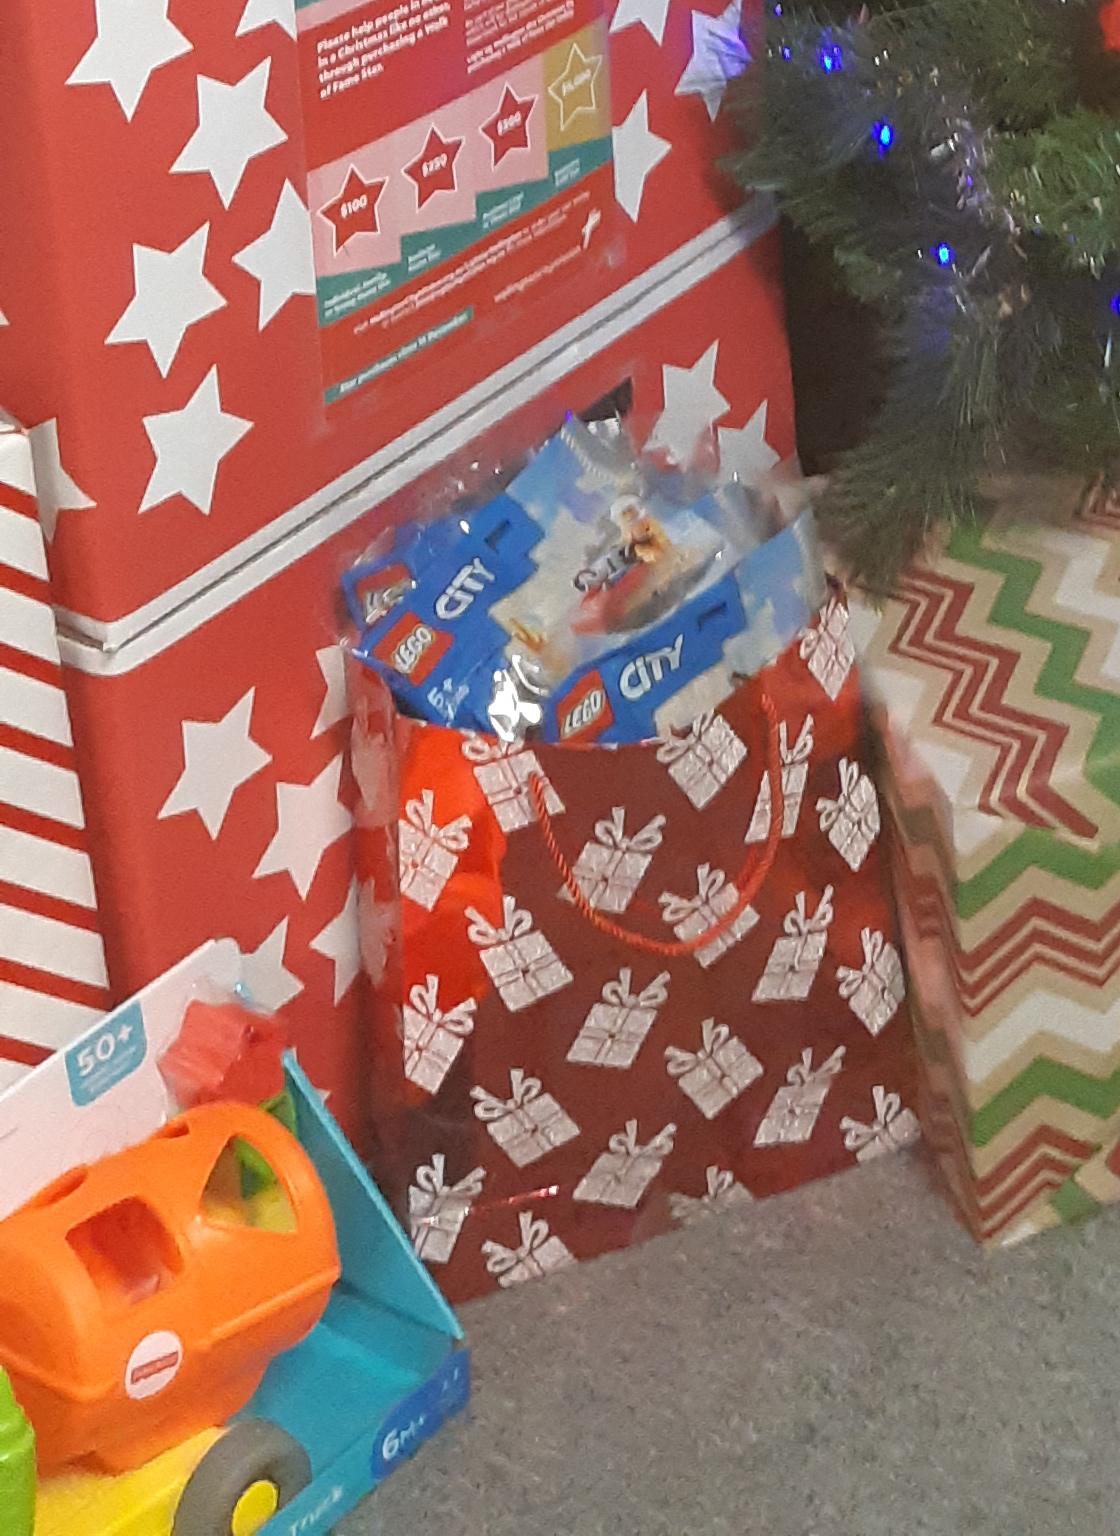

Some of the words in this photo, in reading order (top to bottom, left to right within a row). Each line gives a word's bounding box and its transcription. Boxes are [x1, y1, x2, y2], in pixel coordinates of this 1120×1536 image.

[340, 195, 368, 218] $100
[436, 557, 496, 620] CITY
[394, 623, 435, 675] LEGO
[619, 633, 684, 701] CITY
[562, 689, 604, 738] LEGO
[77, 1024, 133, 1077] 50+
